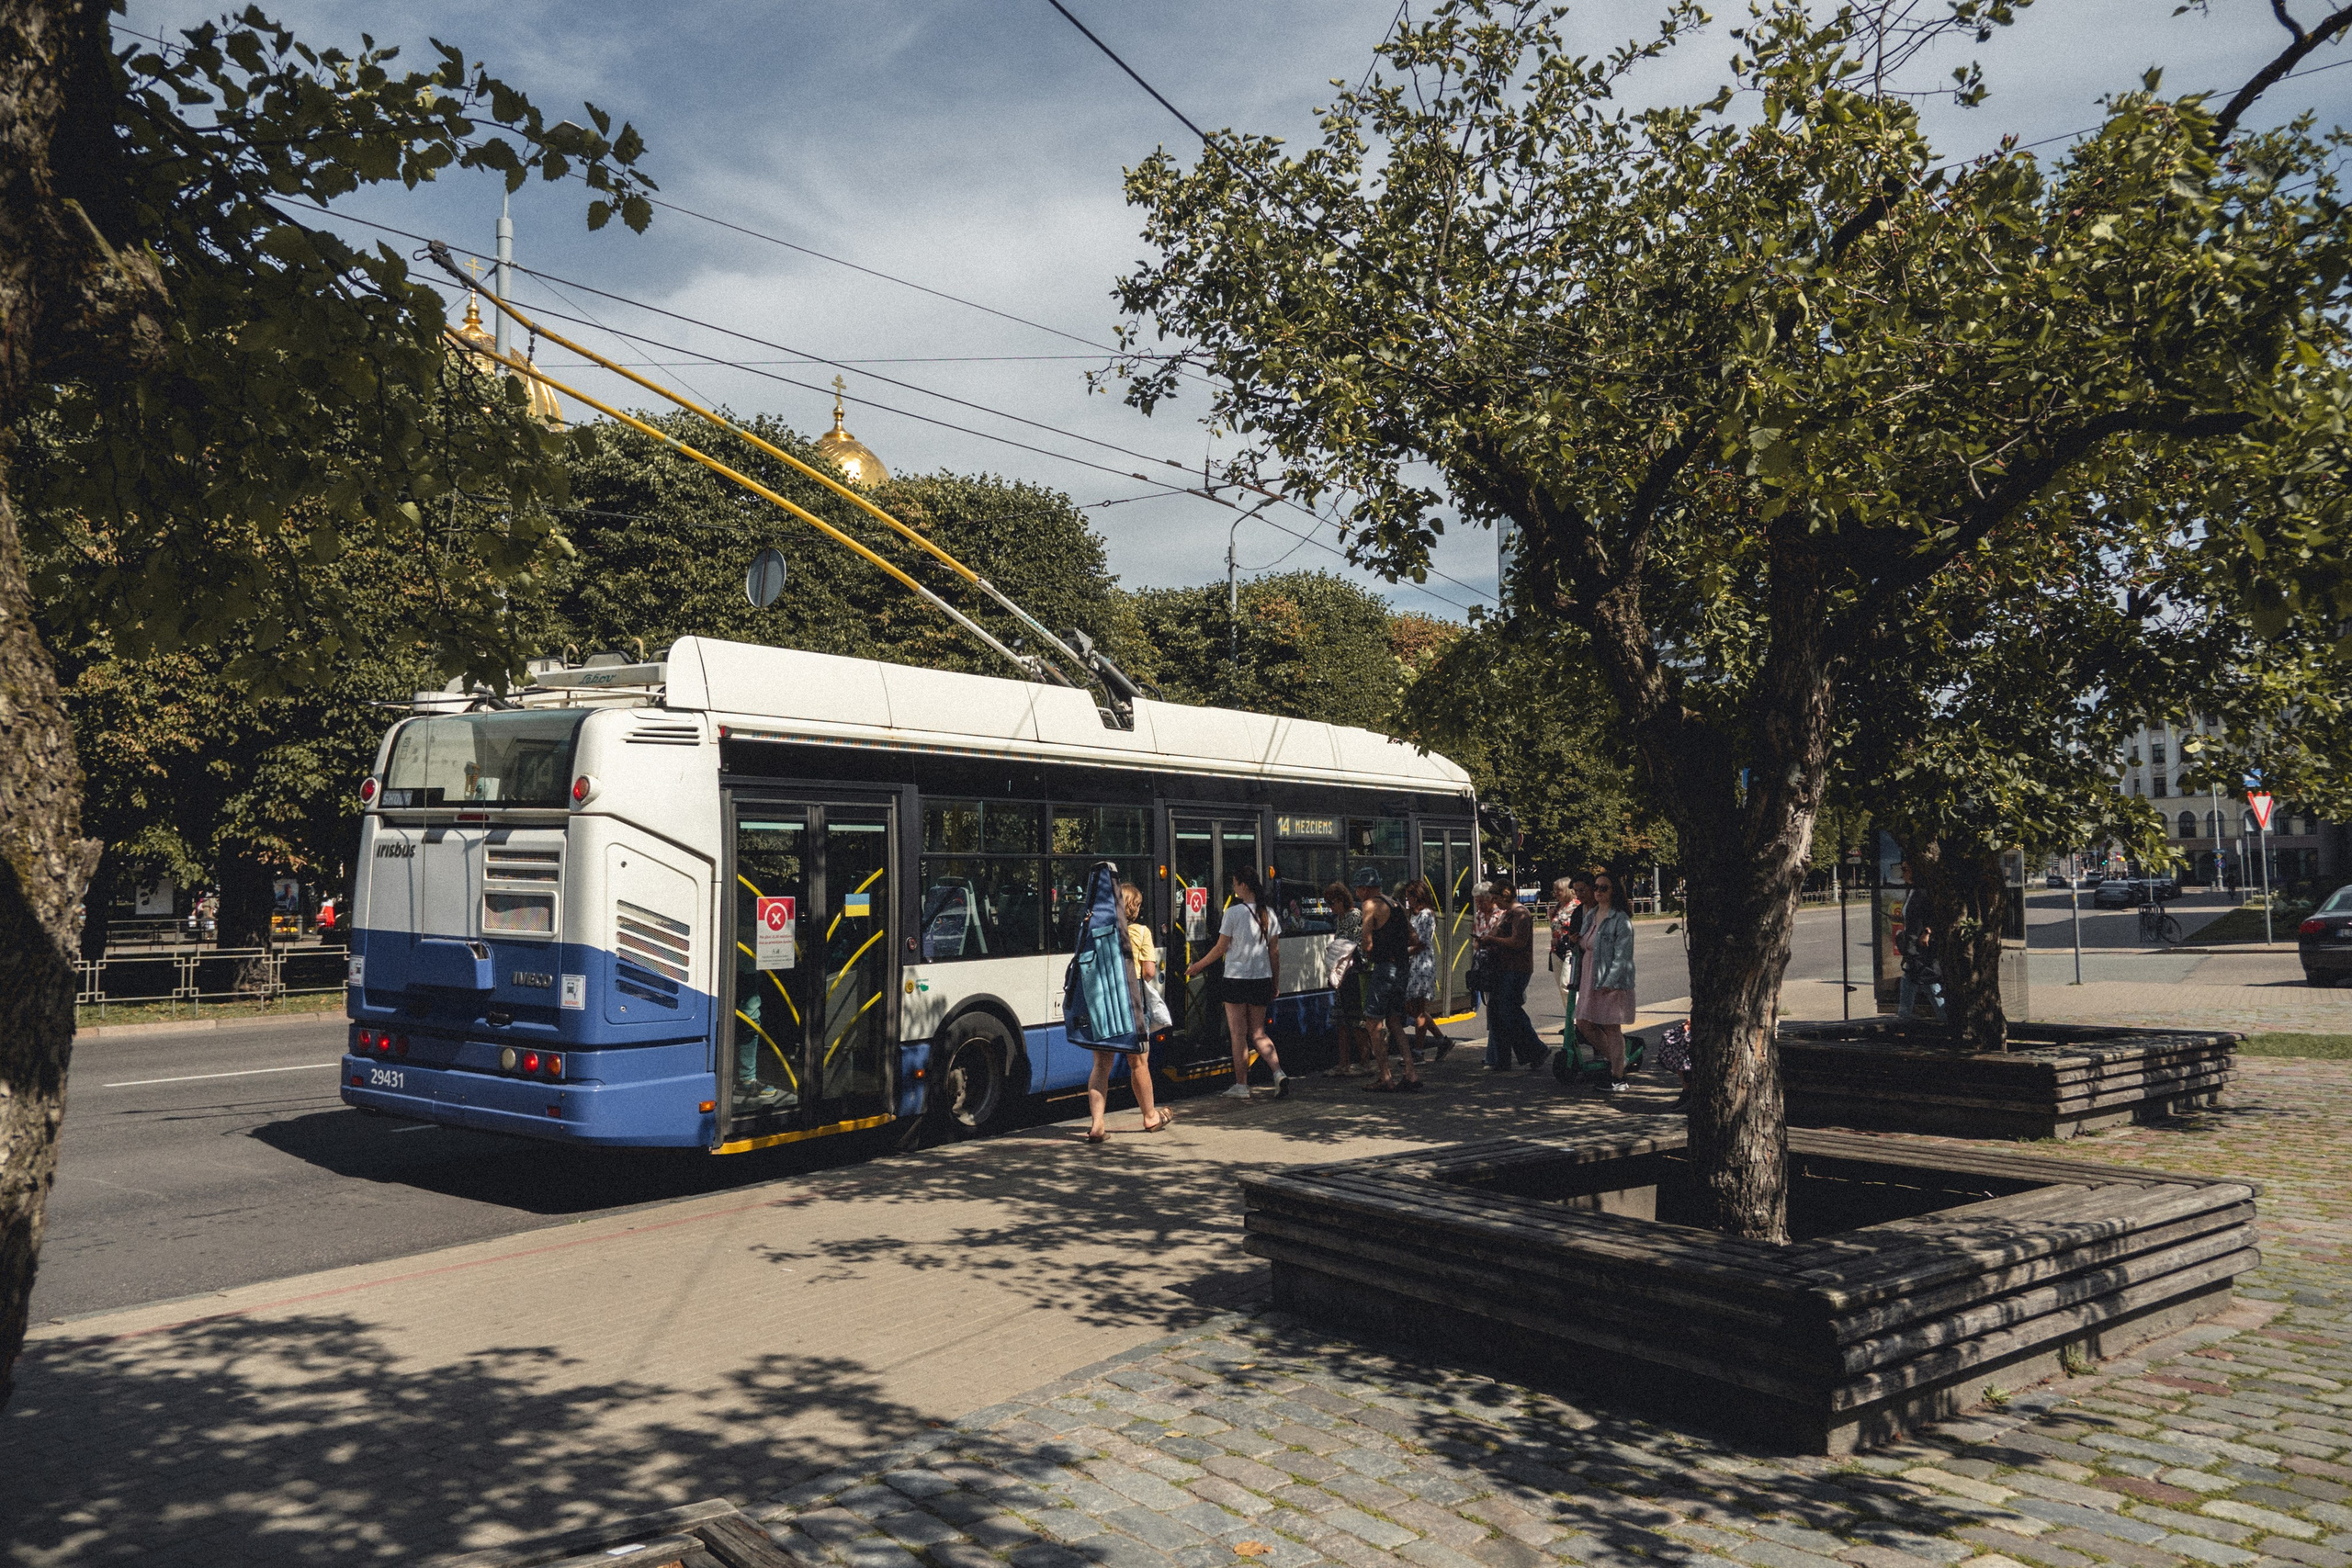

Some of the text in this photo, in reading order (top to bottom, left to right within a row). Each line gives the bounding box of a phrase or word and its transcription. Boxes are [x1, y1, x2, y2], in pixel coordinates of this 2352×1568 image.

[1278, 817, 1290, 836] 14
[512, 971, 553, 987] IVECO
[370, 1068, 404, 1089] 29431
